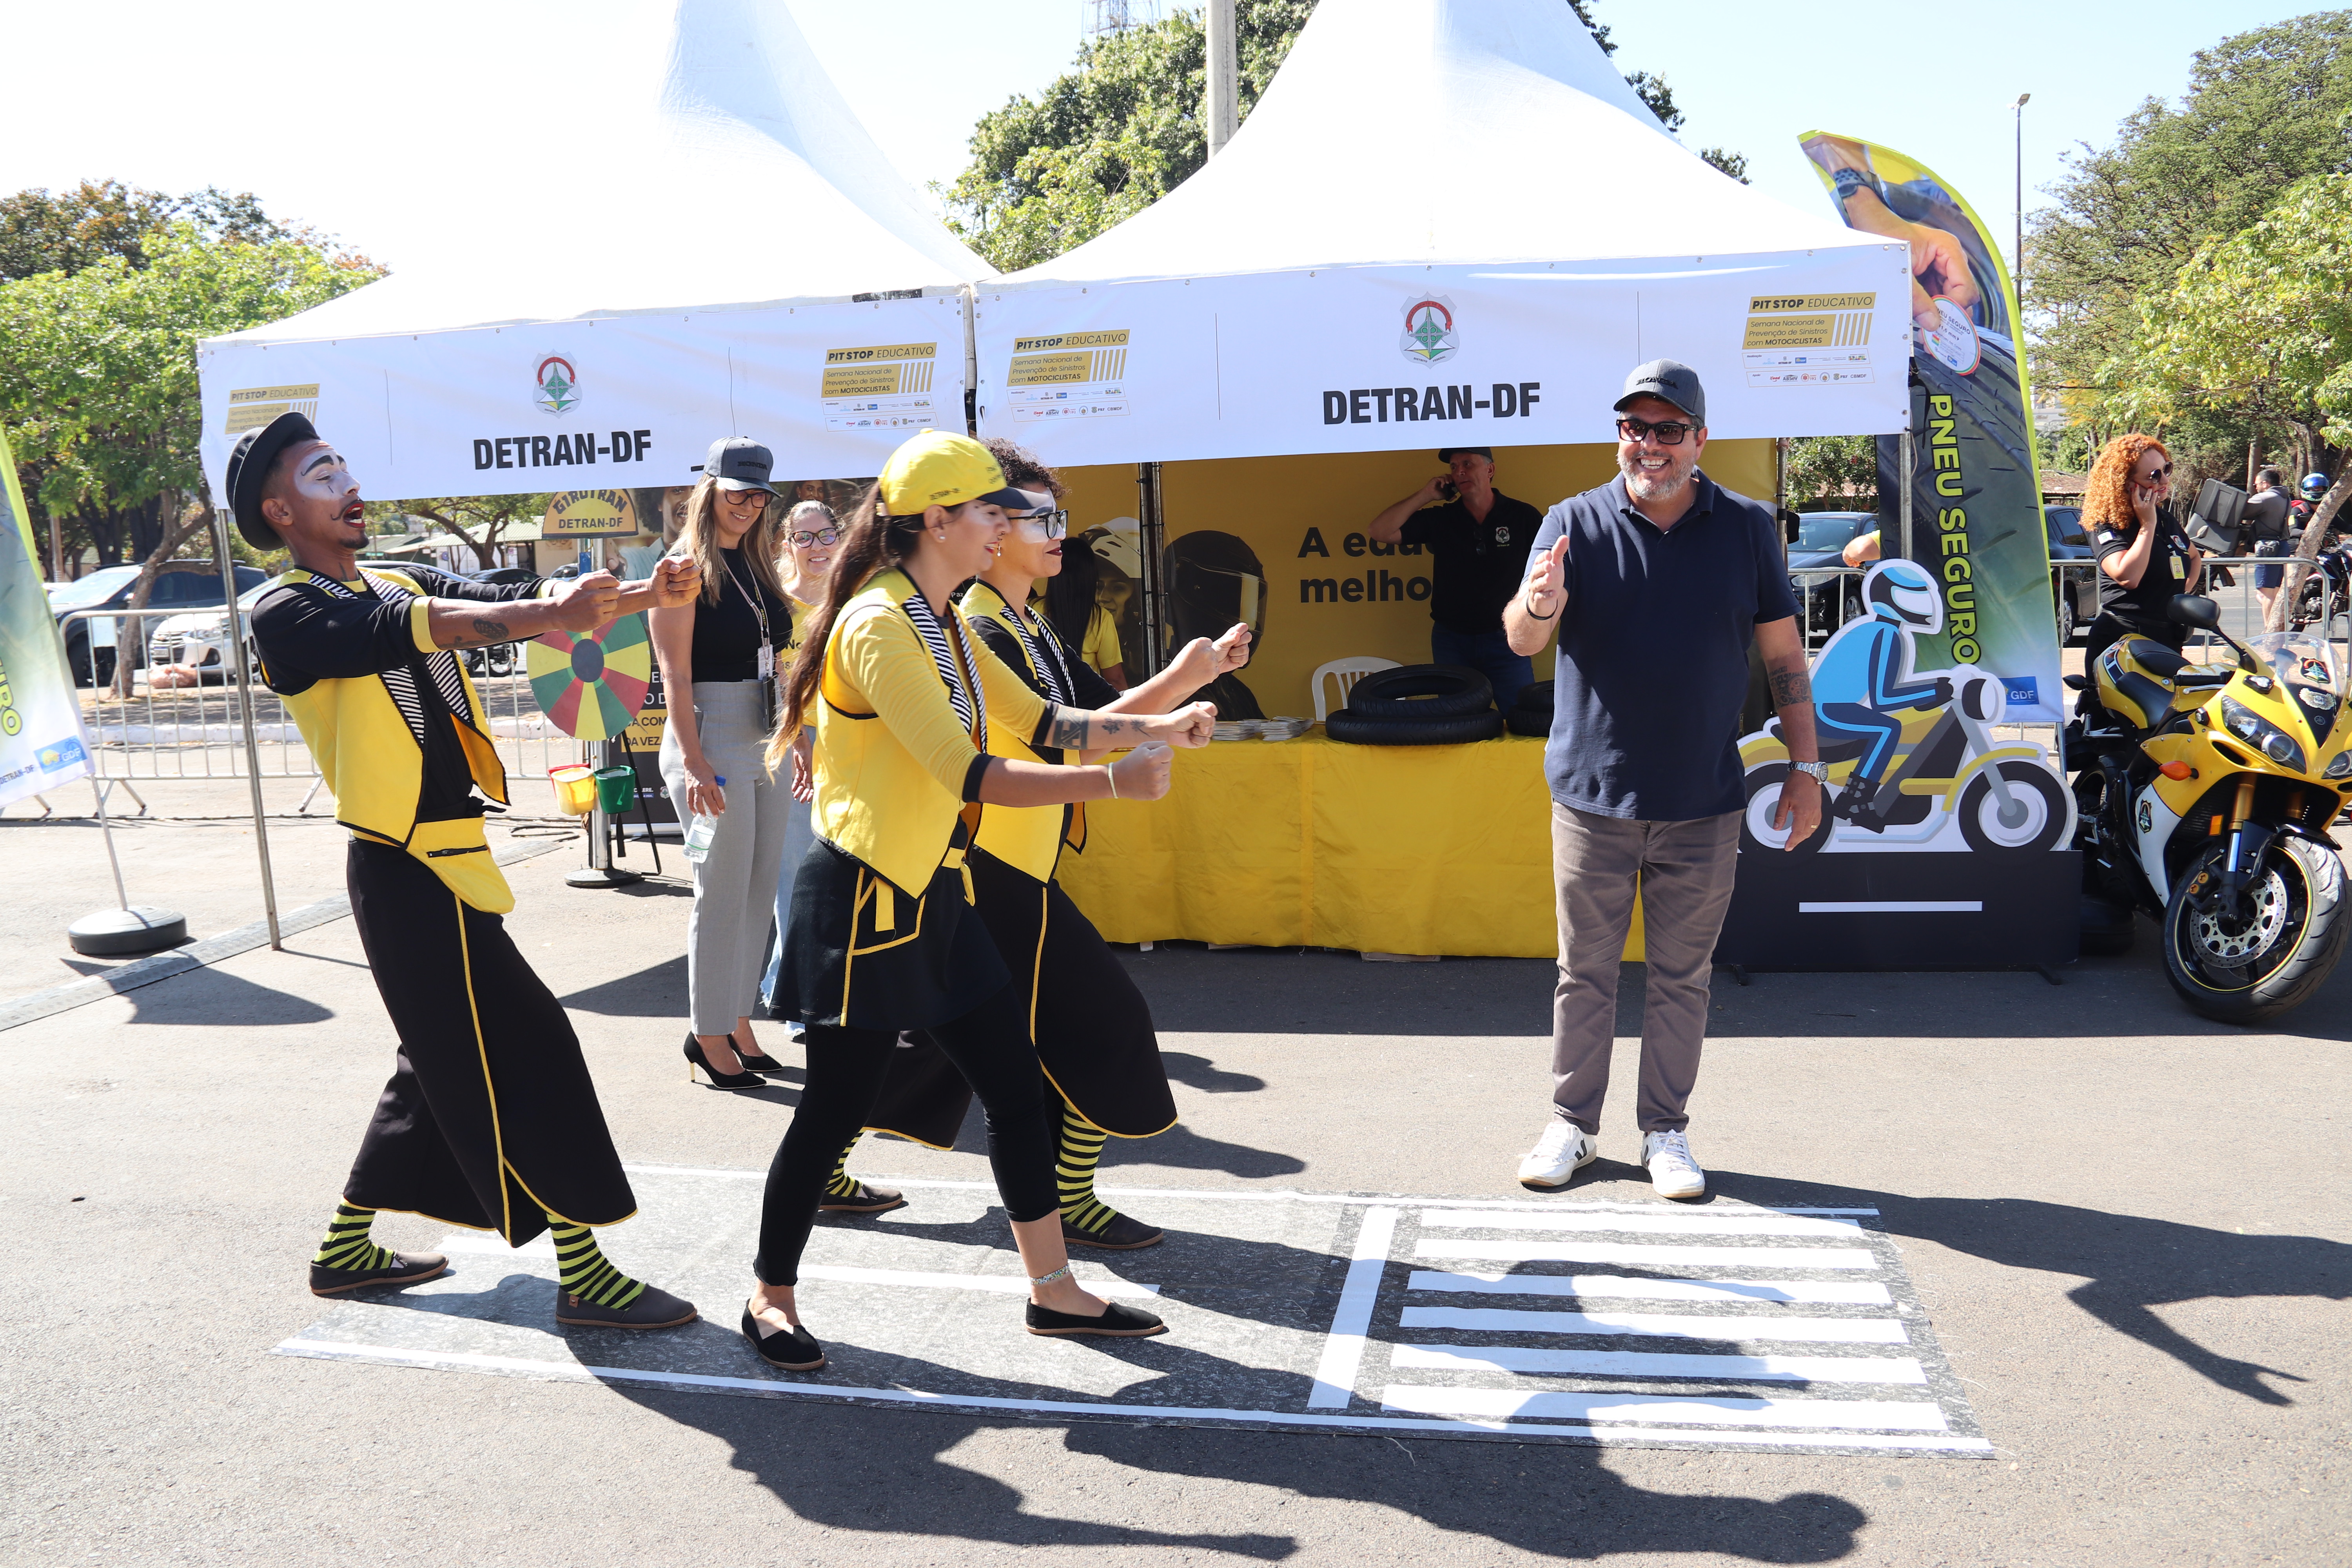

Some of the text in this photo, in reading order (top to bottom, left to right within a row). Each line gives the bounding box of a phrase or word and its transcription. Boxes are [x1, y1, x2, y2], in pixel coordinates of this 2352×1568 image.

[1752, 296, 1872, 309] PIT STOP EDUCATIVO
[1949, 316, 1971, 334] SEGURO
[1016, 333, 1126, 350] PIT STOP EDUCATIVO
[828, 347, 933, 361] PIT STOP EDUCATIVO
[1027, 373, 1081, 382] MOTOCICLISTAS
[1636, 377, 1678, 389] HONDA
[246, 390, 267, 399] STOP
[270, 387, 318, 397] EDUCATIVO
[840, 385, 890, 394] MOTOCICLISTAS
[1323, 382, 1540, 425] DETRAN-DF
[474, 430, 651, 470] DETRAN-DF
[1928, 394, 1963, 498] PNEU
[738, 461, 767, 470] HONDA
[559, 517, 623, 528] DETRAN-DF
[1298, 527, 1330, 557] A
[1938, 506, 1981, 665] SEGURO
[2011, 690, 2034, 700] GDF
[62, 748, 82, 762] GDF
[0, 765, 35, 784] DETRAN-DF
